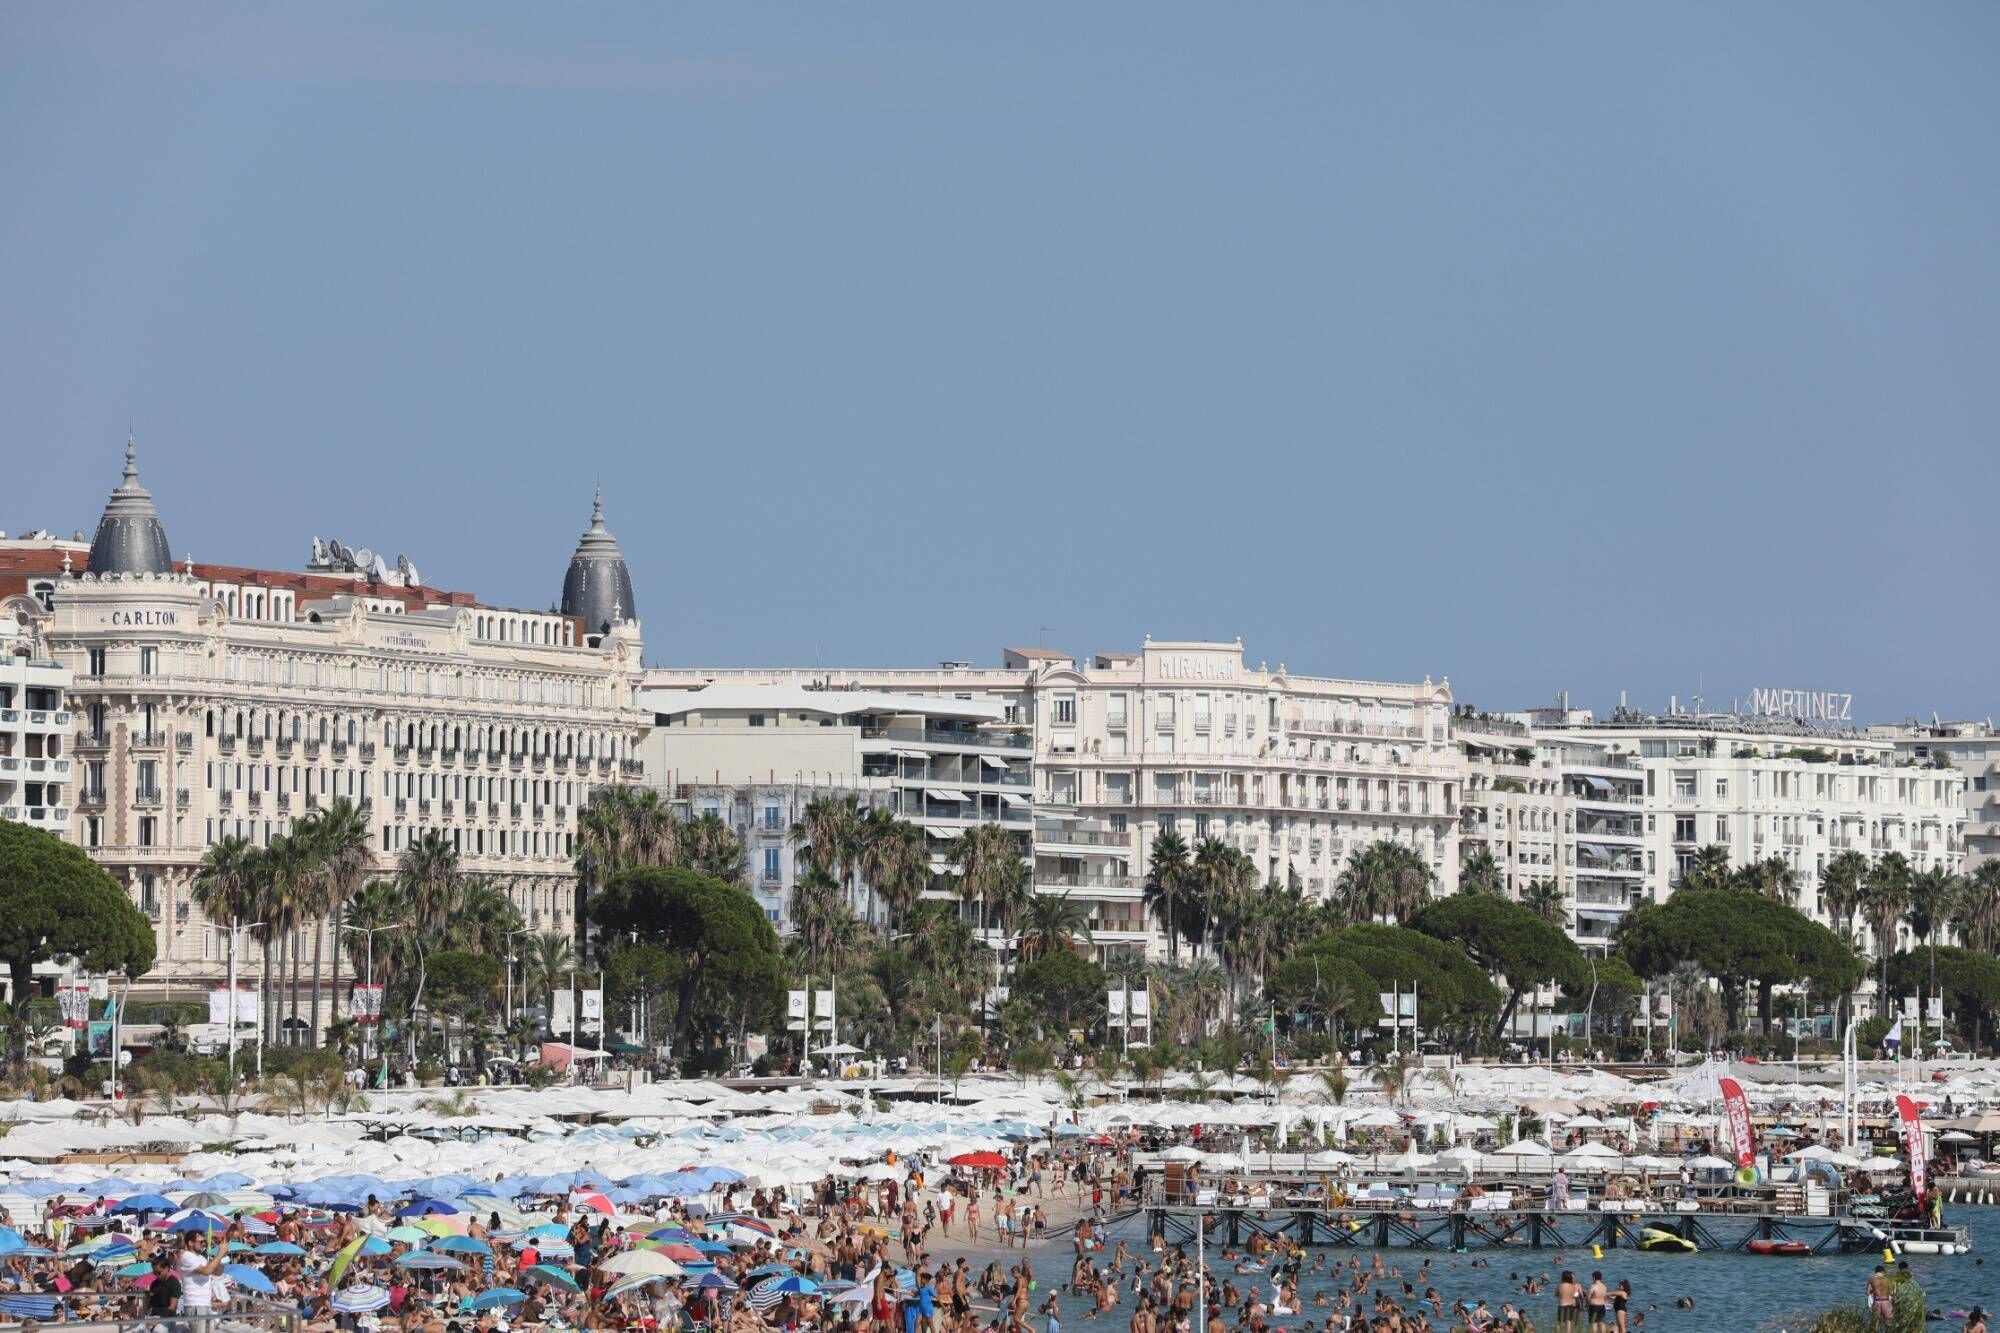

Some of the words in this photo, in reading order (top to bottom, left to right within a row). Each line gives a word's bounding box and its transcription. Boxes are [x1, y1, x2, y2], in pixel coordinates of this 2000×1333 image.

[112, 611, 175, 625] CARLTON
[384, 635, 427, 648] INTERCONTINENTAL
[1160, 655, 1233, 680] MIRAMAR
[1753, 687, 1852, 720] MARTINEZ
